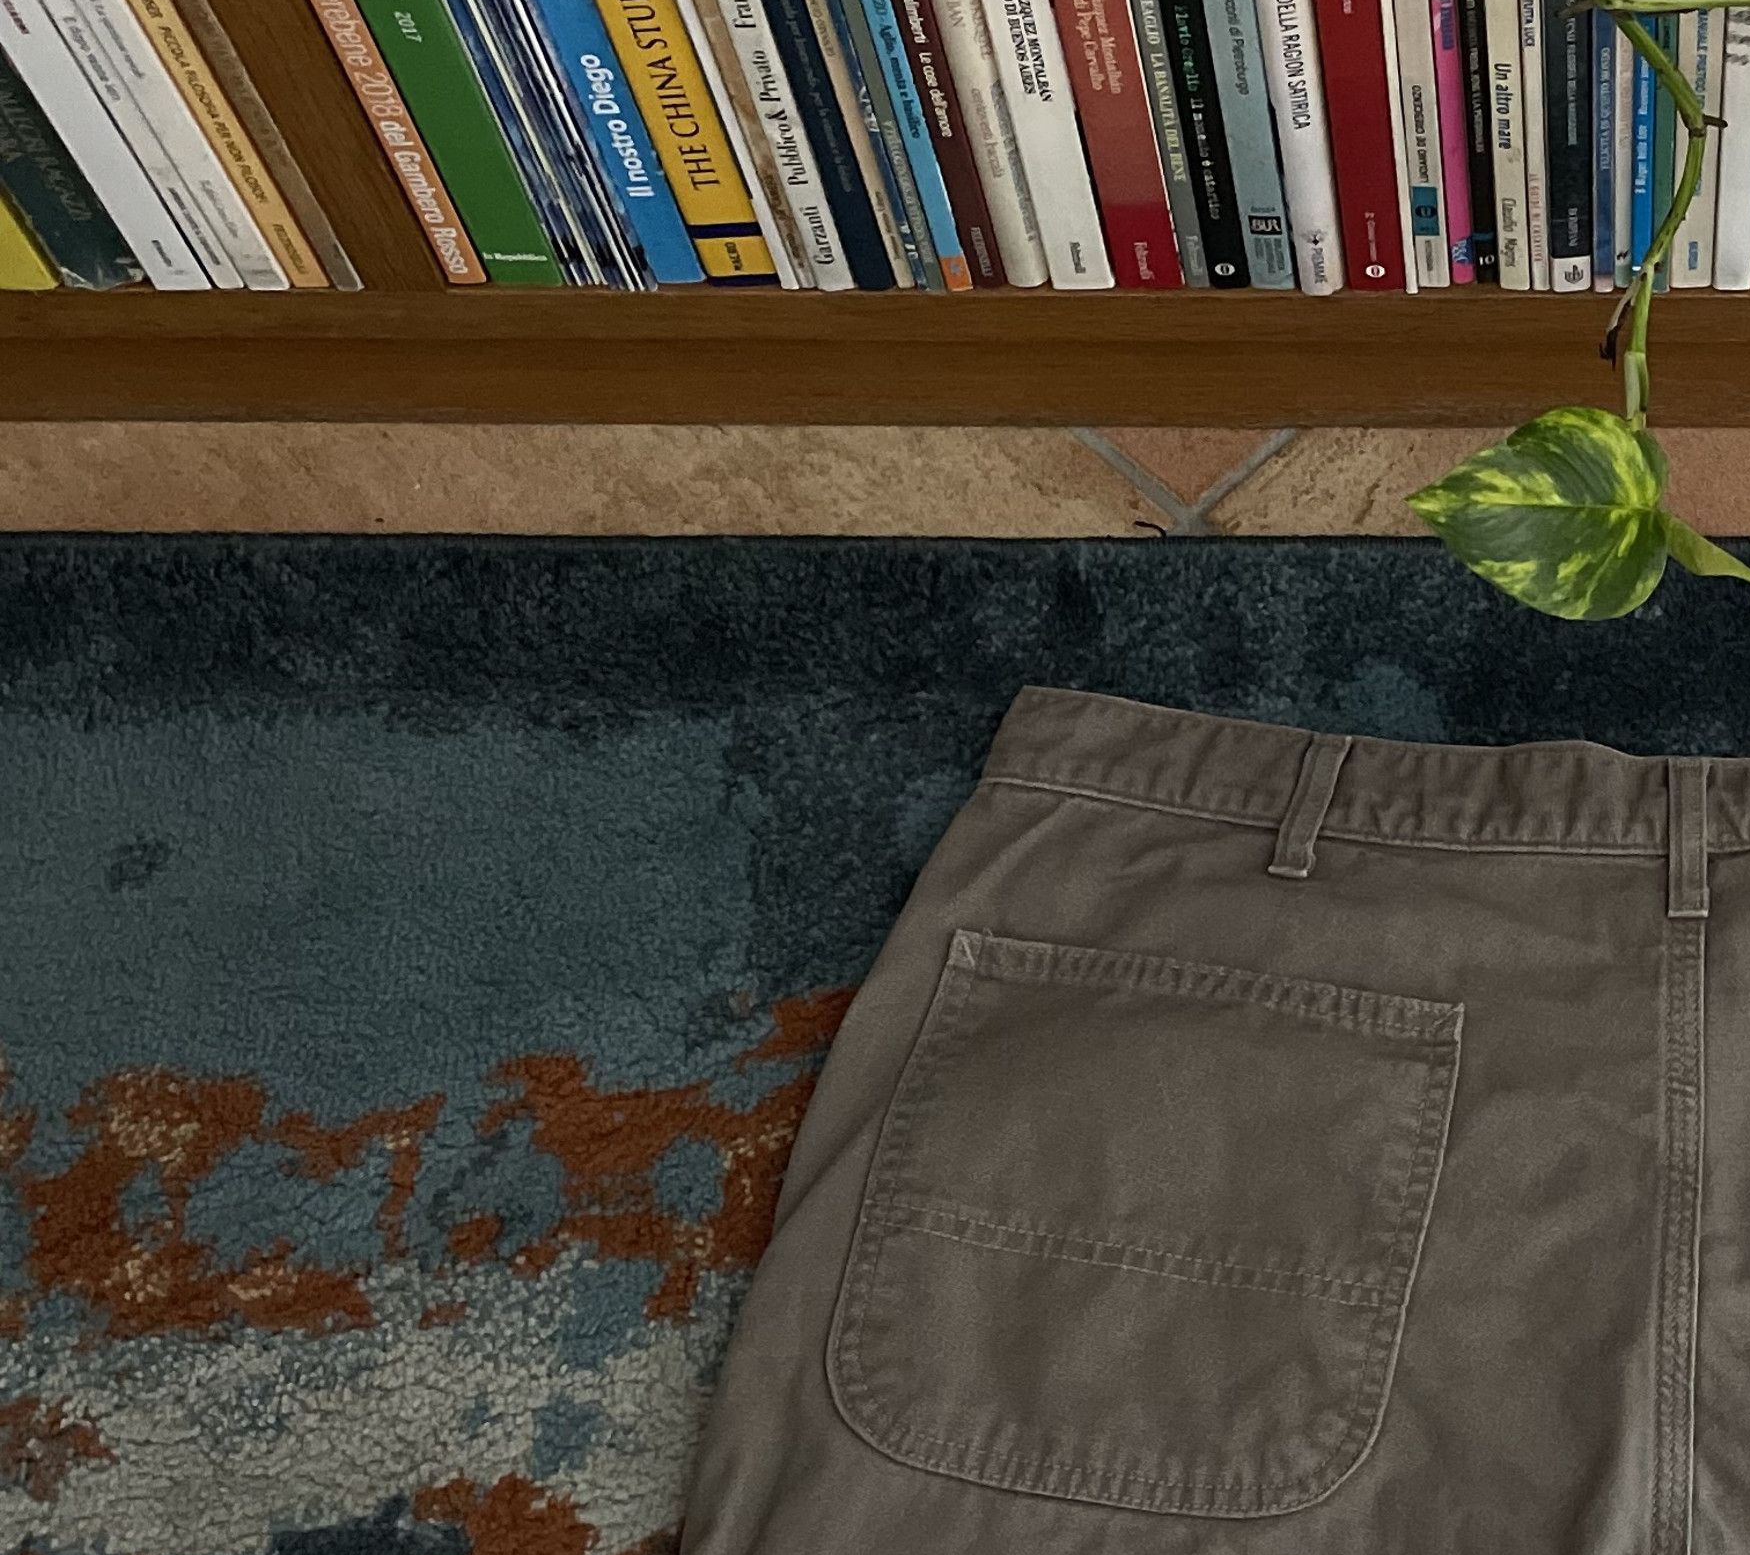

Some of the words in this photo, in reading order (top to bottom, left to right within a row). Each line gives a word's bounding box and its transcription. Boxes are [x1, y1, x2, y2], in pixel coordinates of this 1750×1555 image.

[1282, 36, 1304, 81] RAGION
[1494, 63, 1510, 80] Un
[356, 62, 402, 122] 2018
[581, 53, 618, 114] Diego
[647, 56, 703, 142] CHINA
[1287, 83, 1311, 132] SATIRICA
[1495, 83, 1511, 115] altro
[605, 119, 647, 180] nostro
[1498, 118, 1512, 150] mare
[628, 179, 655, 198] Il
[679, 144, 721, 192] THE
